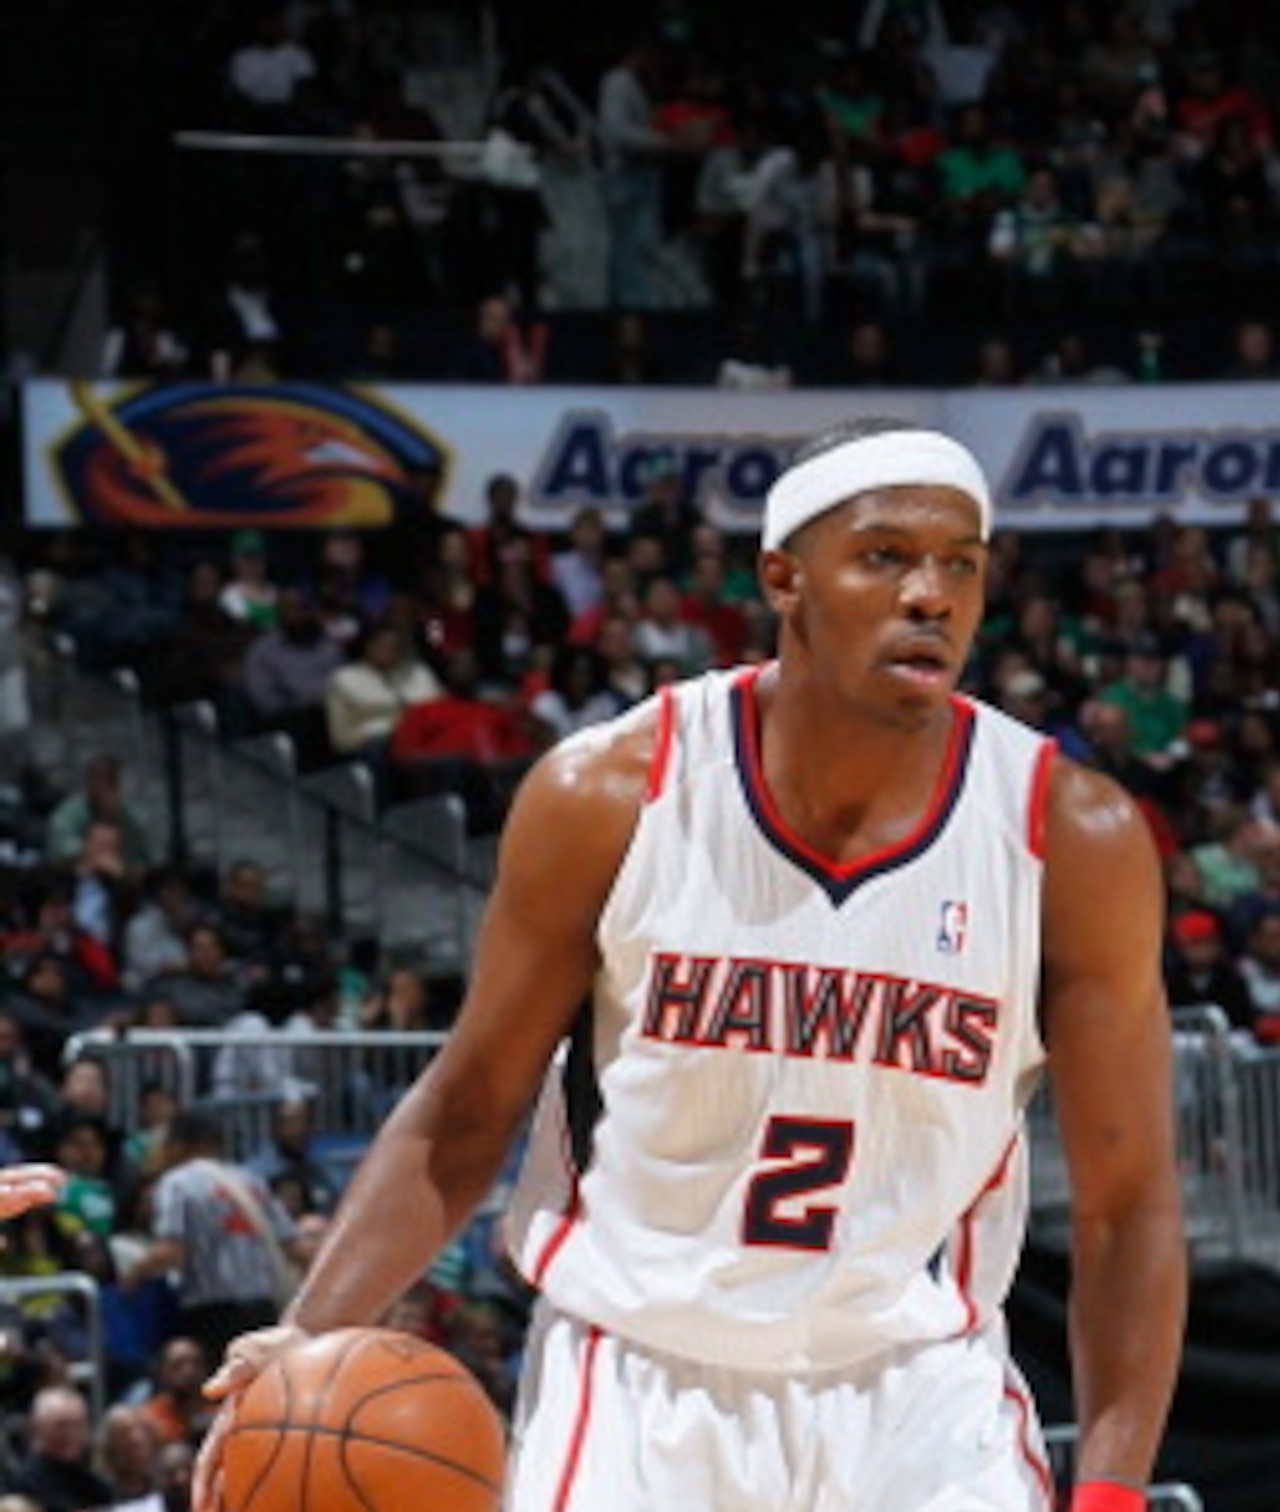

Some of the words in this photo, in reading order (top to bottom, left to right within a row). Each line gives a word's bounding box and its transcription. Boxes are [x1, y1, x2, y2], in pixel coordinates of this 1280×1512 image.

[536, 417, 788, 503] Aaro
[641, 952, 1001, 1087] HAWKS
[741, 1115, 856, 1253] 2
